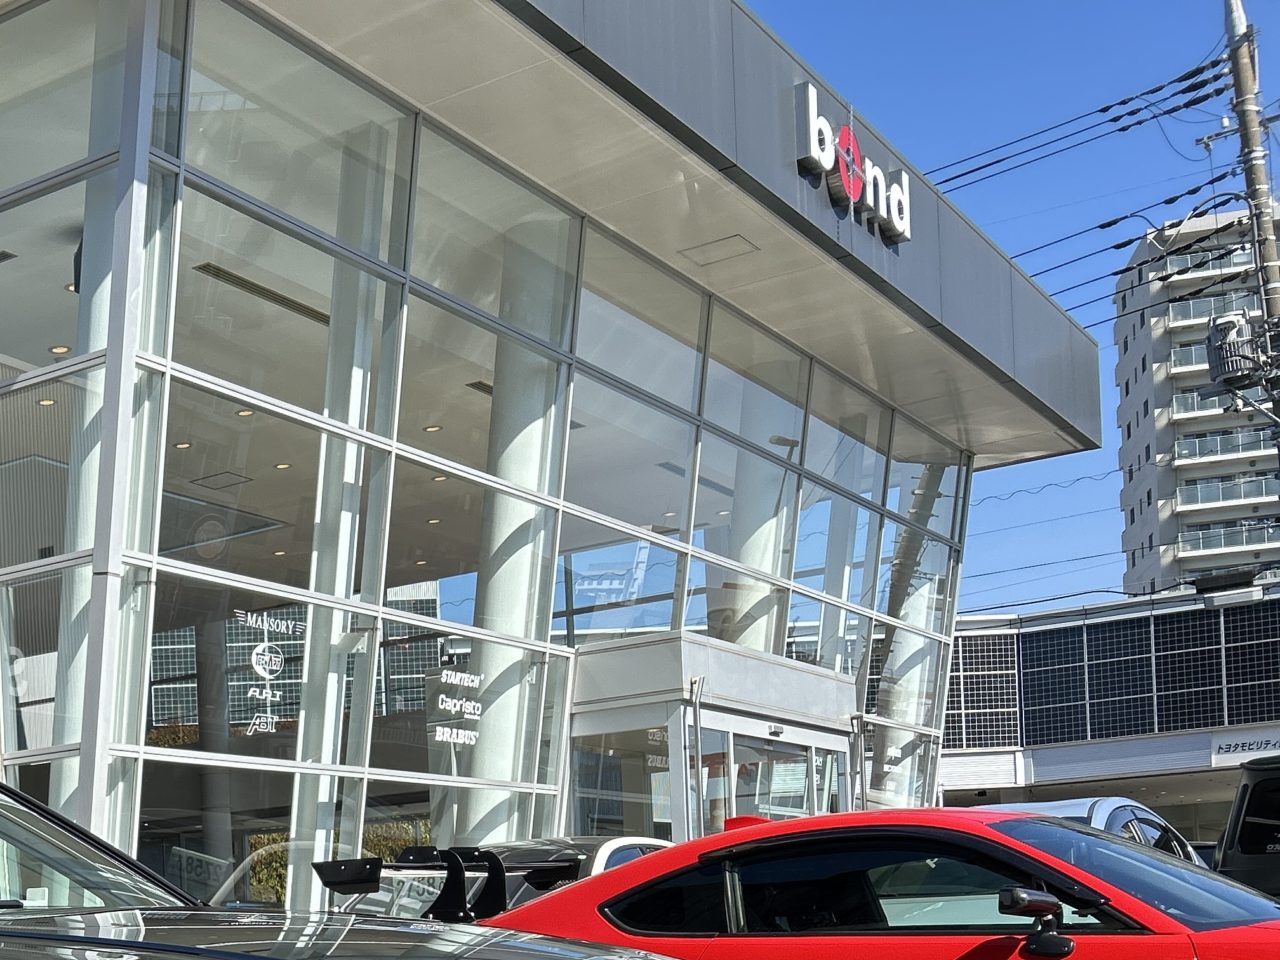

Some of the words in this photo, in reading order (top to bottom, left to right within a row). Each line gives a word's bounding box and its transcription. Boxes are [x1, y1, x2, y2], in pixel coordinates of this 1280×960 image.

[799, 82, 911, 241] bond
[246, 612, 295, 634] MANSORY
[441, 670, 481, 688] STARTECH
[439, 694, 482, 714] Capristo
[246, 713, 280, 736] ABT
[435, 726, 478, 745] BRABUS
[1217, 740, 1280, 754] トヨタモビリティ
